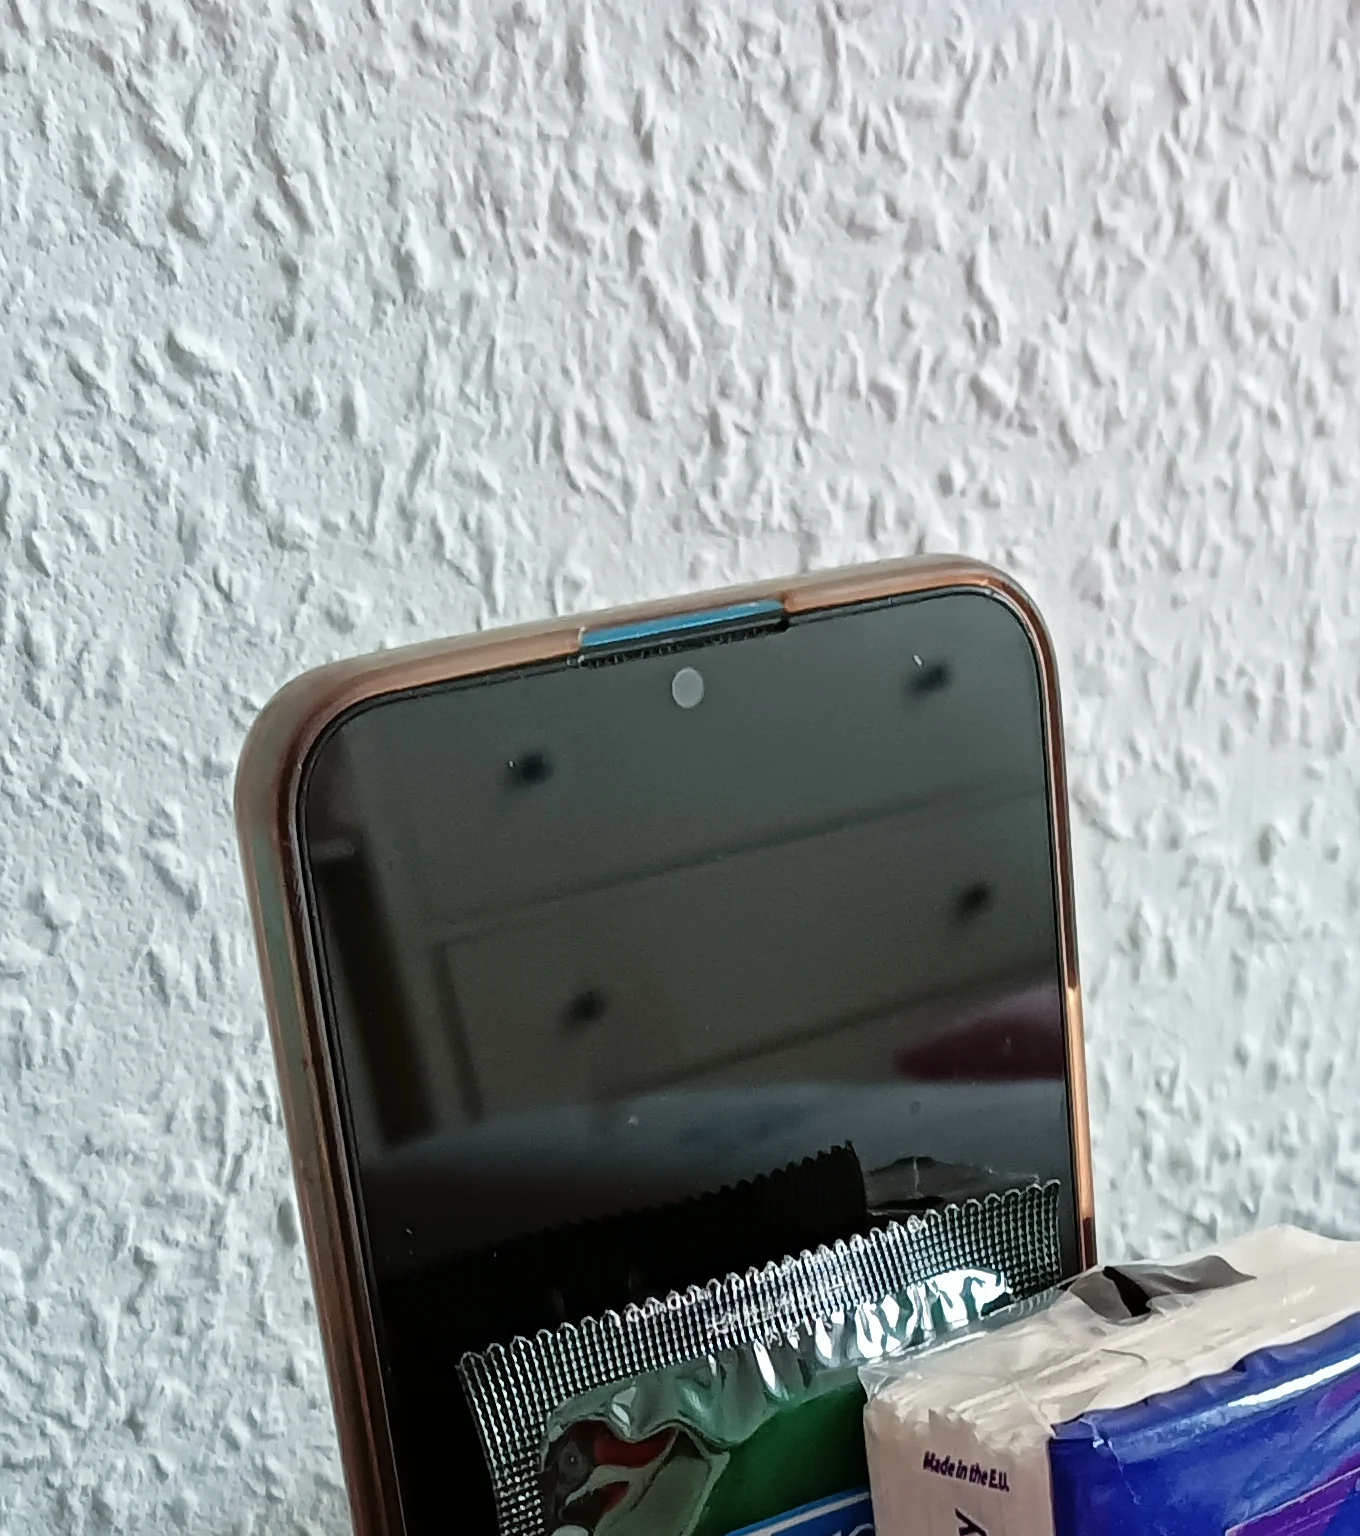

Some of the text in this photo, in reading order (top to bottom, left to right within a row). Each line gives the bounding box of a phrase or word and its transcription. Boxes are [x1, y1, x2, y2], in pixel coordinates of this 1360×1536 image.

[923, 1451, 1010, 1492] Made in the E.U.
